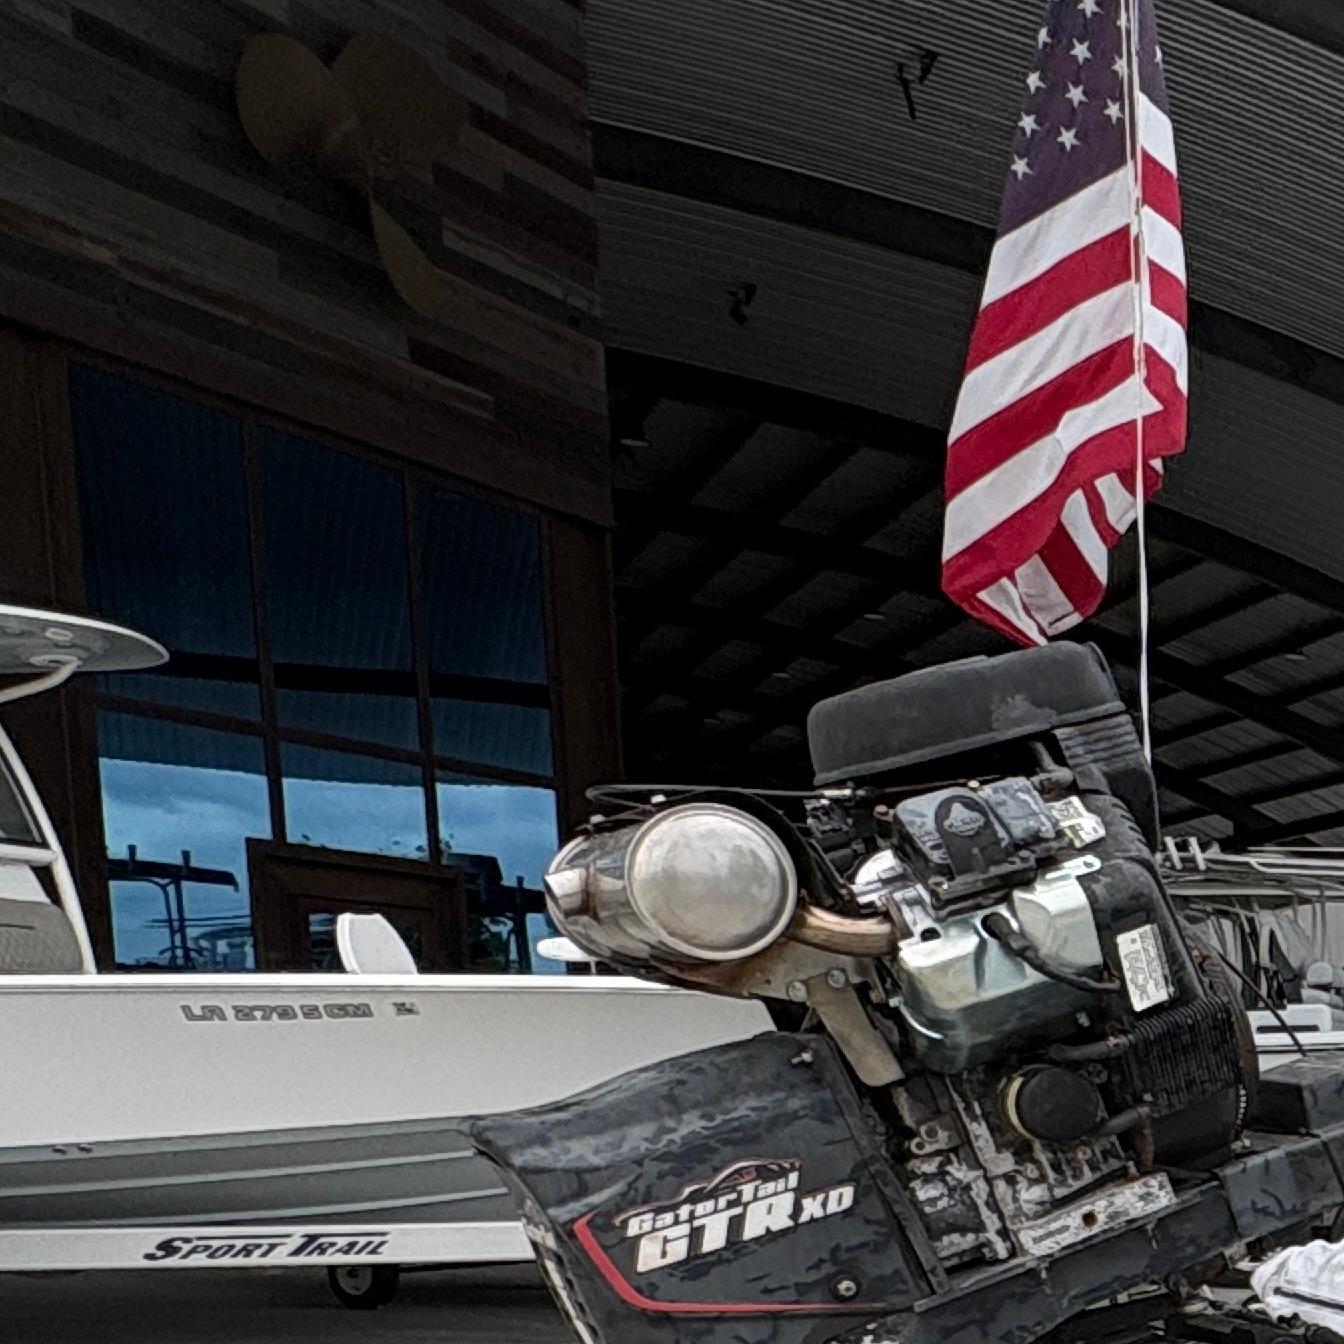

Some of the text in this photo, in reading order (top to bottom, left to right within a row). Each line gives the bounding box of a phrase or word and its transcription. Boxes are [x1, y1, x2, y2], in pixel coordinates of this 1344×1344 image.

[181, 1004, 228, 1022] LA
[625, 1171, 800, 1238] GatorTail
[636, 1184, 856, 1273] GTR XD
